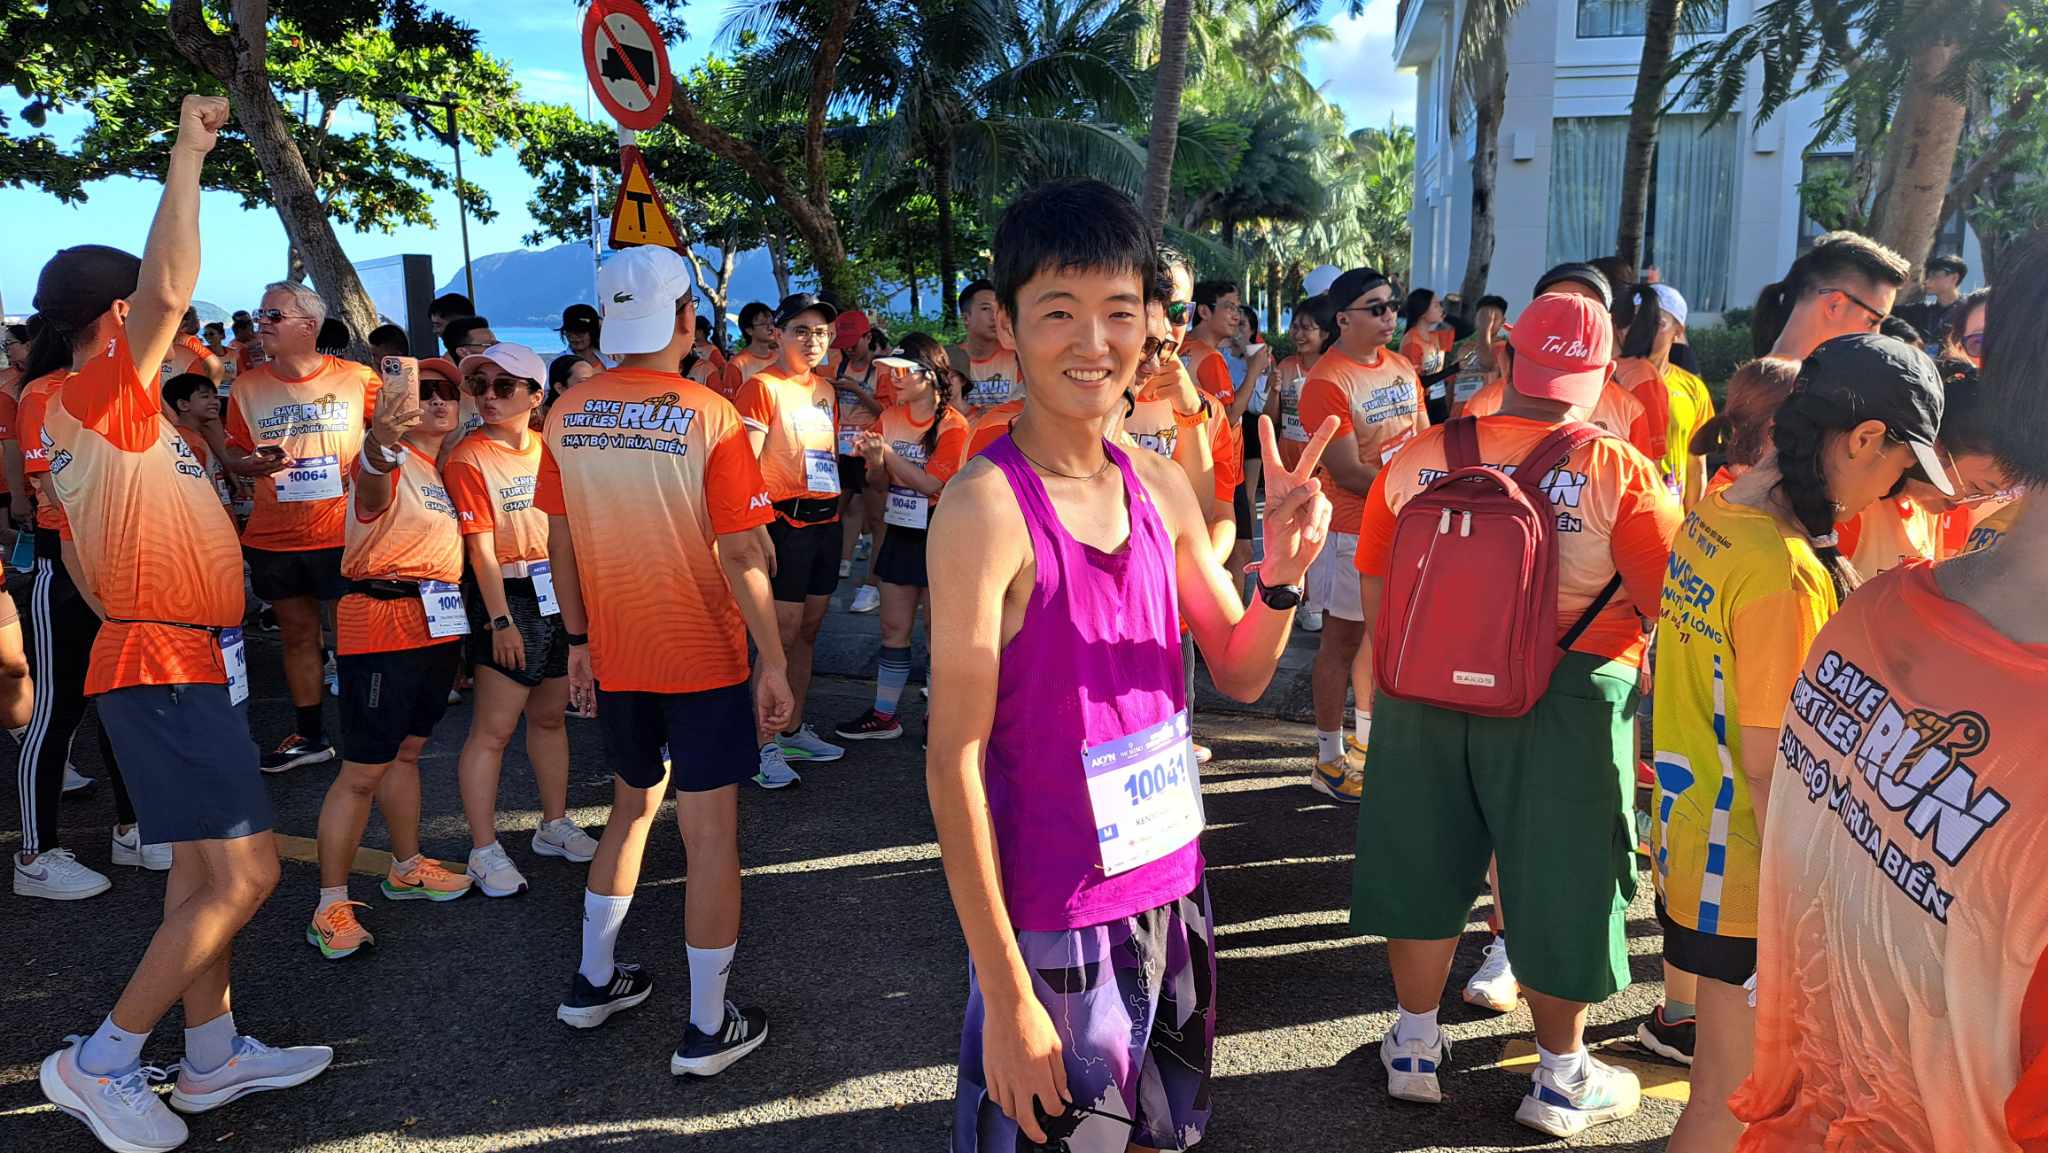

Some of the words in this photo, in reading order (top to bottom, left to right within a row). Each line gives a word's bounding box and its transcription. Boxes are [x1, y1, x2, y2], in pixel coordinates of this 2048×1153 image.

[273, 405, 301, 417] SAVE
[301, 402, 348, 420] RUN
[584, 400, 622, 414] SAVE
[563, 413, 618, 428] TURTLES
[619, 402, 696, 436] RUN
[589, 433, 609, 450] BỘ
[609, 433, 625, 448] VÌ
[288, 469, 328, 482] 10064
[1816, 650, 1889, 723] SAVE
[1124, 753, 1186, 806] 10041
[1855, 697, 2011, 867] RUN
